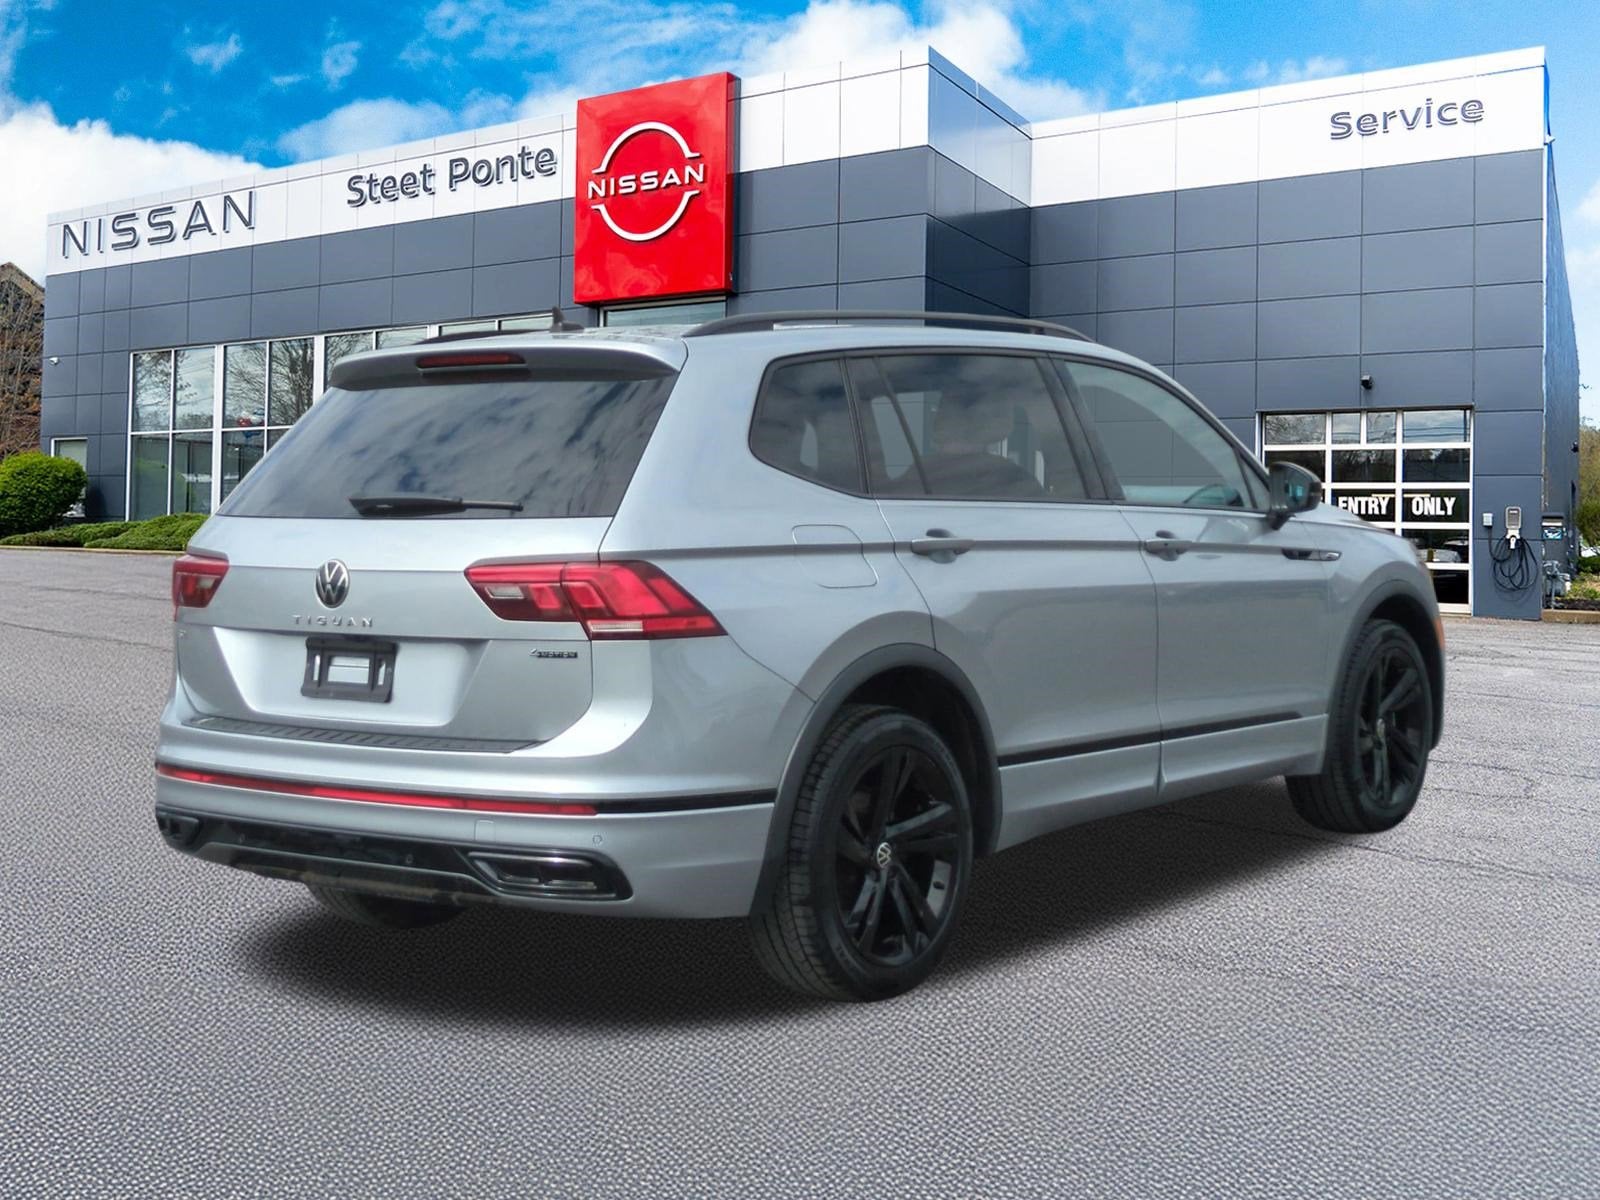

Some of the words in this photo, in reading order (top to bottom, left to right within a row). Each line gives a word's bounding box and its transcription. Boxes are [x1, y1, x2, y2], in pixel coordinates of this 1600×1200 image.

[1330, 98, 1484, 140] Service
[347, 163, 435, 207] Steet
[449, 146, 557, 191] Ponte
[587, 163, 705, 199] NISSAN
[62, 191, 255, 259] NISSAN
[1338, 496, 1390, 515] ENTRY
[1411, 496, 1456, 516] ONLY
[292, 614, 373, 628] TIGUAN
